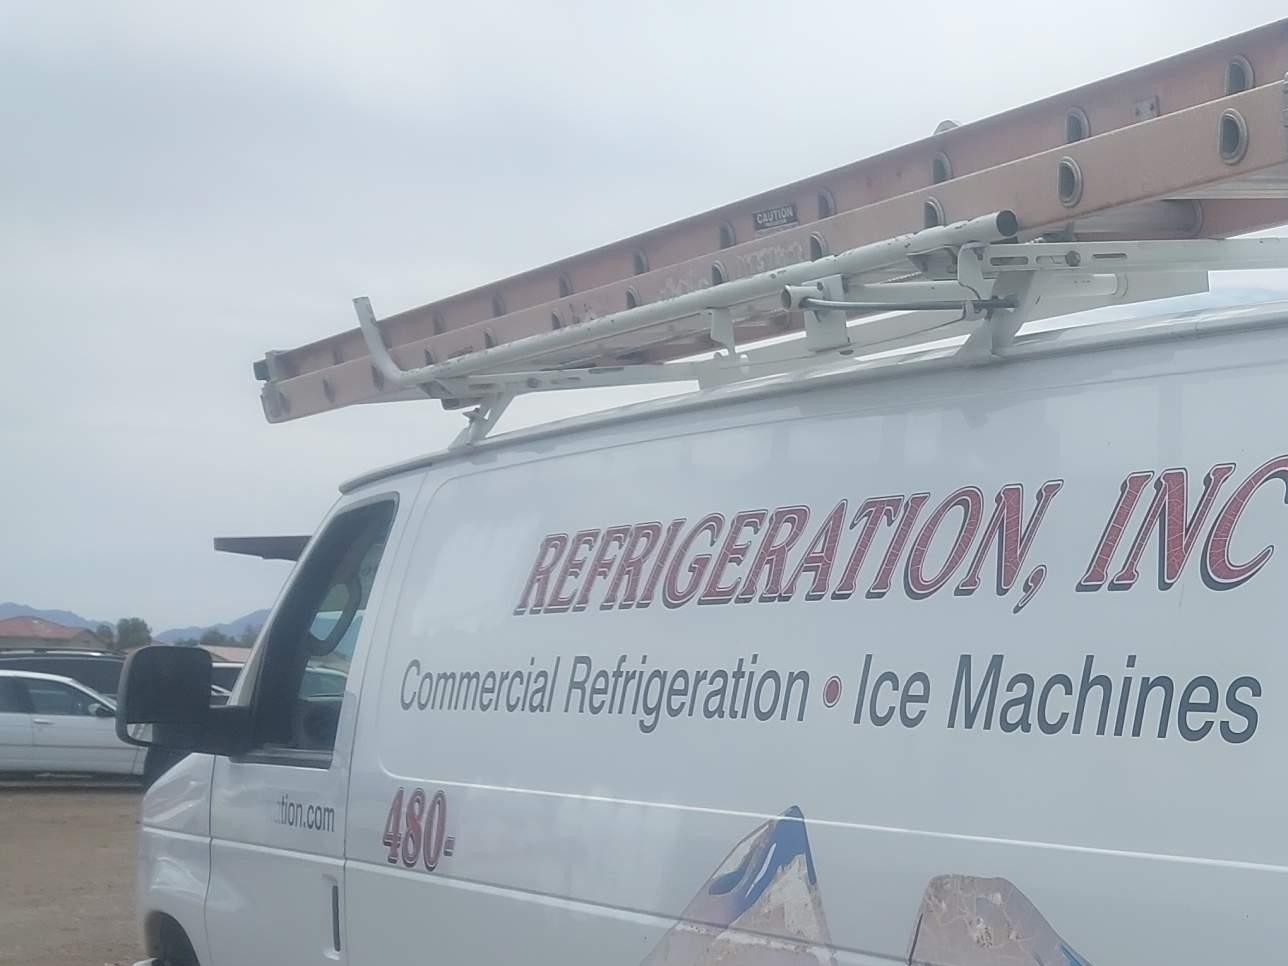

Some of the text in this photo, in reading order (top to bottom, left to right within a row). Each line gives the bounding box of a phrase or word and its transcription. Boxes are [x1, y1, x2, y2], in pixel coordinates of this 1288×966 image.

[755, 206, 794, 225] CAUTION
[513, 479, 1064, 616] REFRIGERATION,
[400, 653, 1263, 746] Commercial Refrigeration Ice Machines
